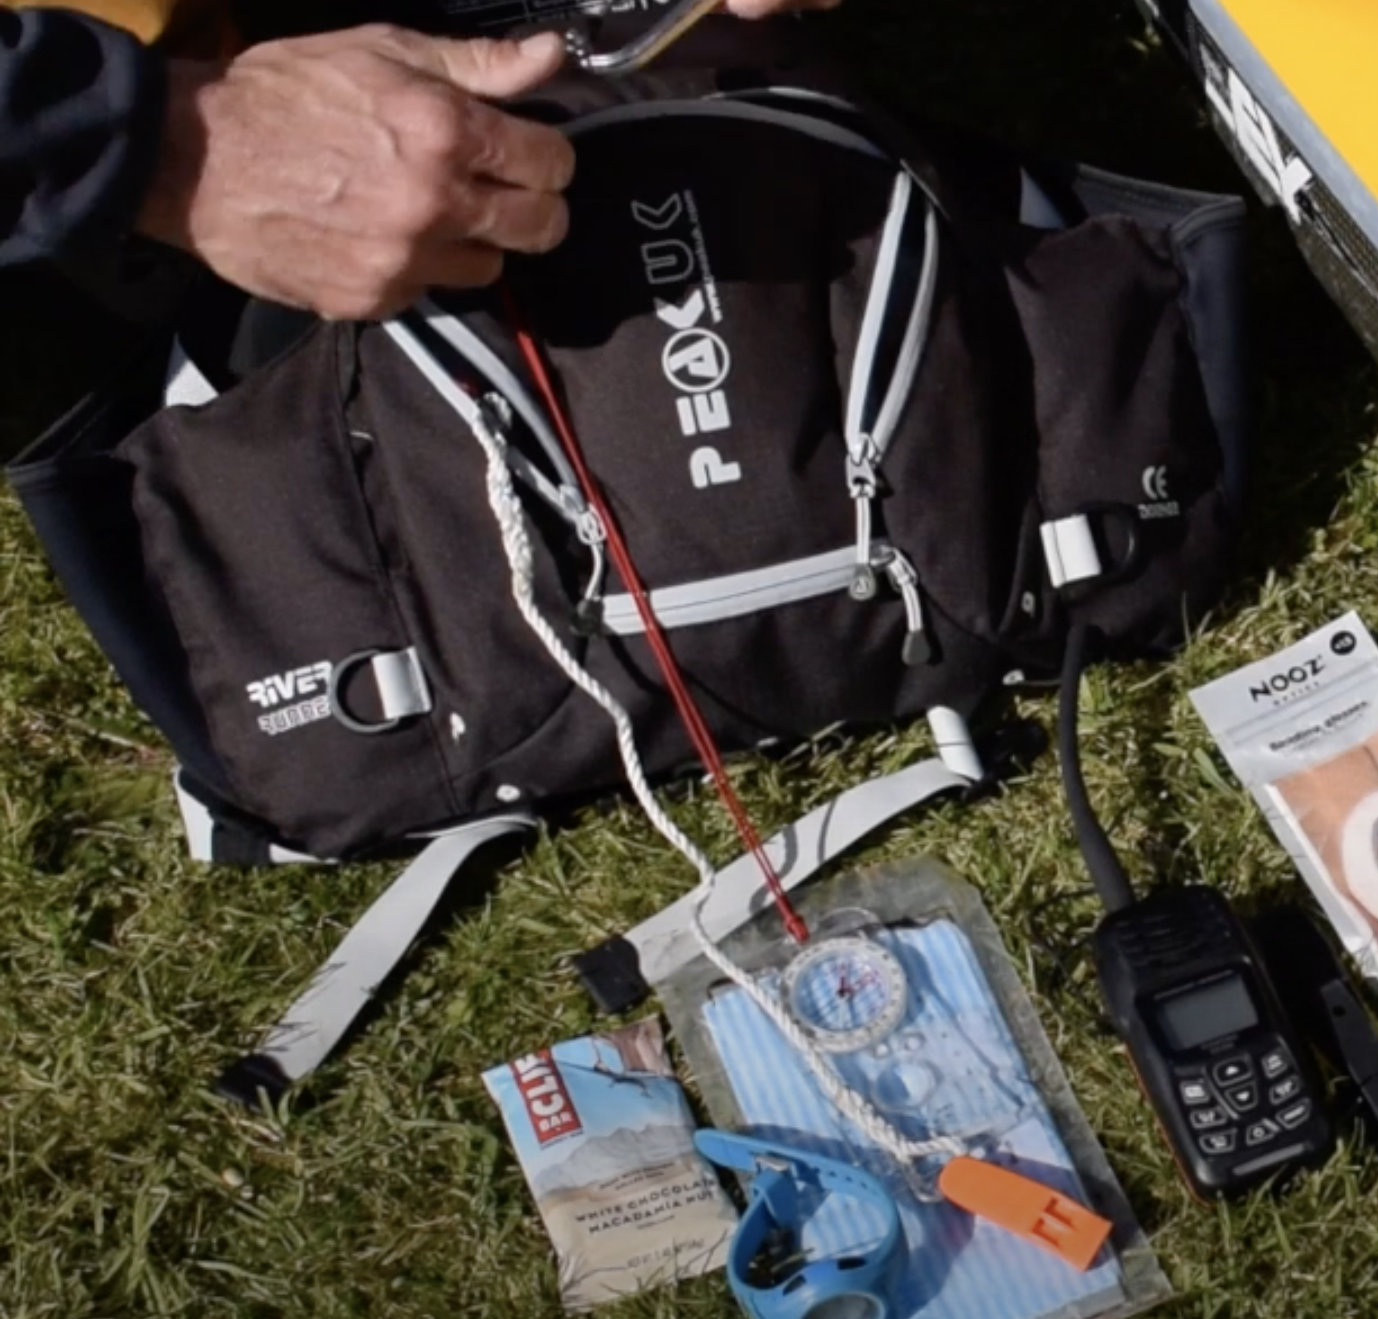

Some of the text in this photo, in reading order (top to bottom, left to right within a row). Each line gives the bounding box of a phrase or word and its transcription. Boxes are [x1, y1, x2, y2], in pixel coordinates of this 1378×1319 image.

[1141, 465, 1169, 501] CE
[1248, 658, 1326, 703] NOOZ
[575, 1203, 623, 1223] WHITE
[588, 1200, 682, 1234] MACADAMIA
